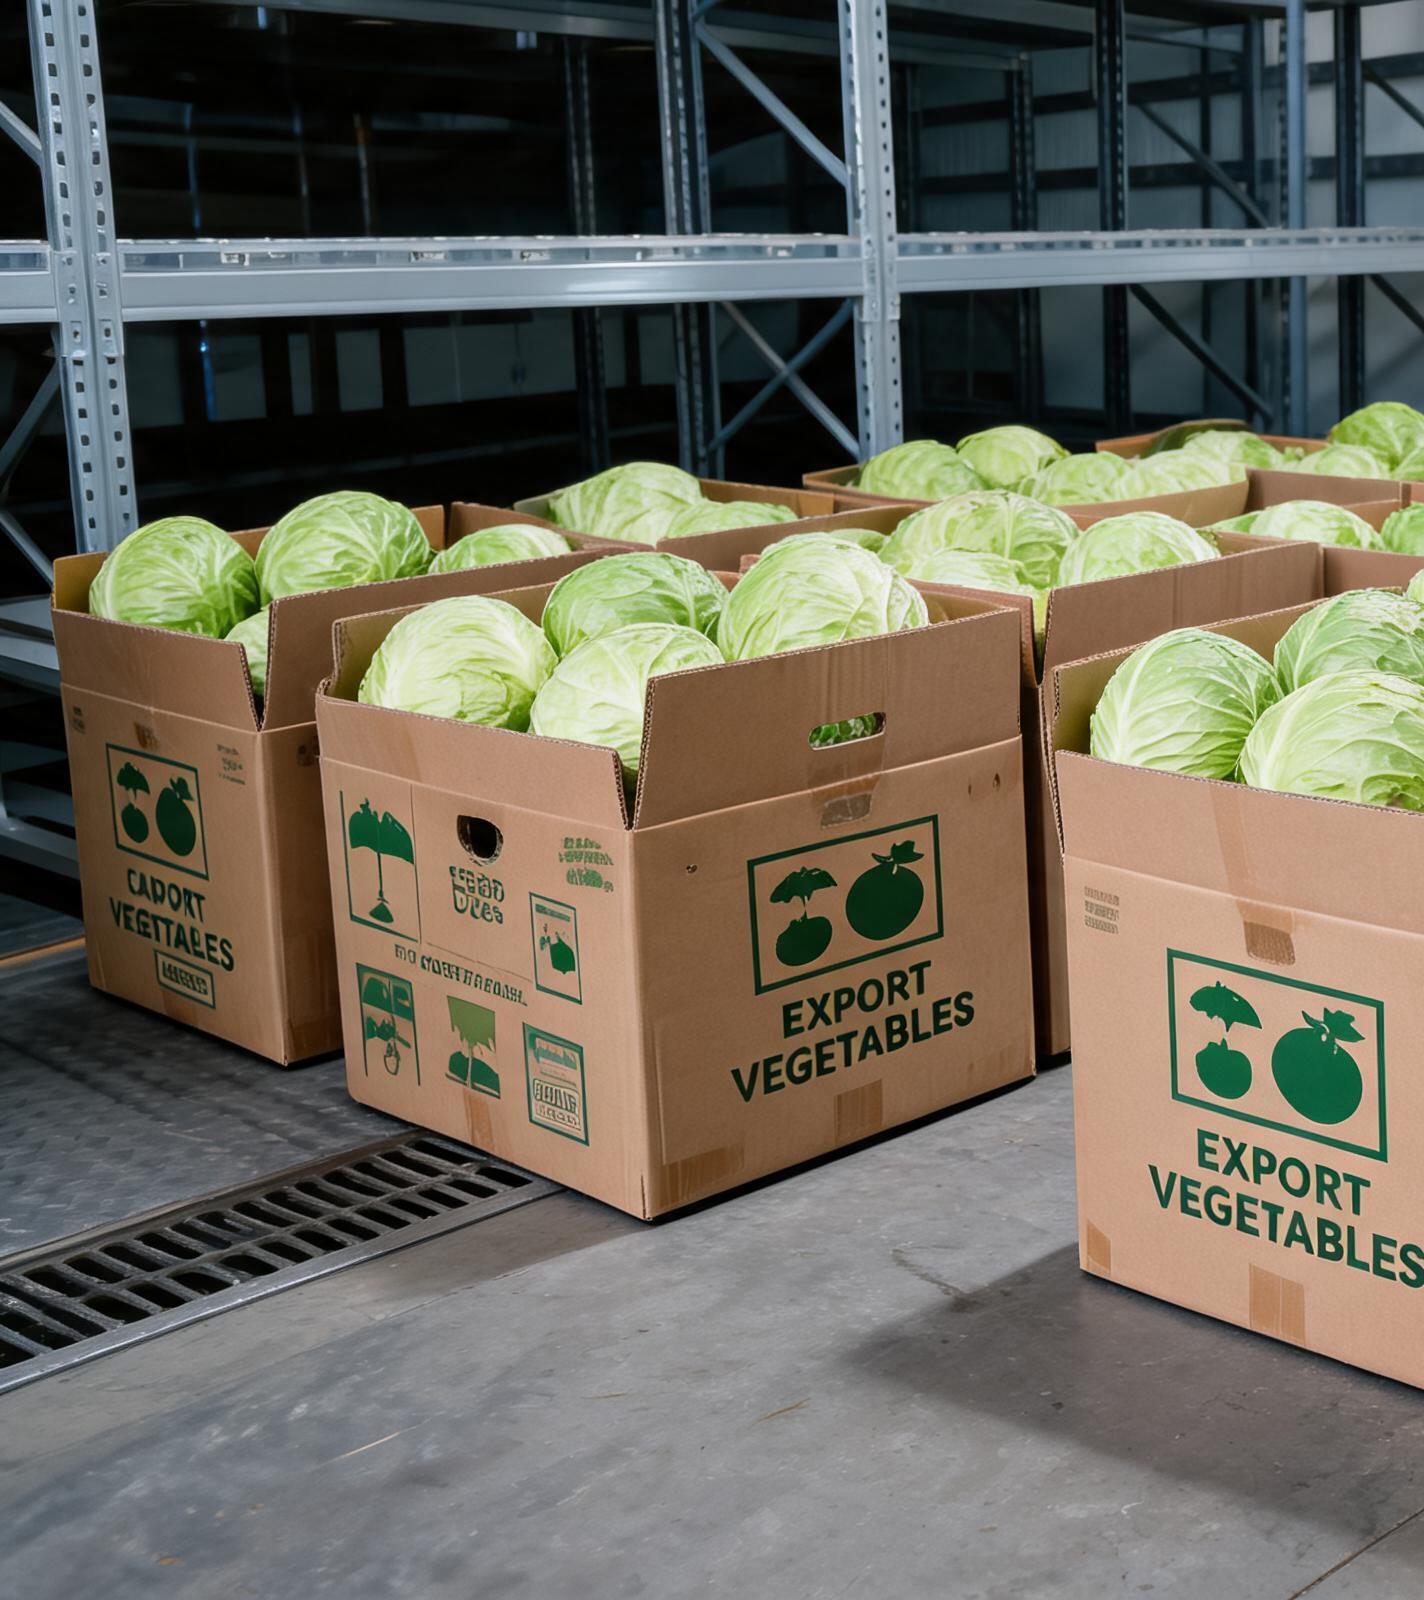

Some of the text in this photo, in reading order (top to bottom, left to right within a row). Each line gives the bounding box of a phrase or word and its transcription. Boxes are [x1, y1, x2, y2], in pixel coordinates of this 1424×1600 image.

[782, 960, 932, 1039] EXPORT
[731, 991, 975, 1103] VEGETABLES
[1196, 1128, 1371, 1216] EXPORT
